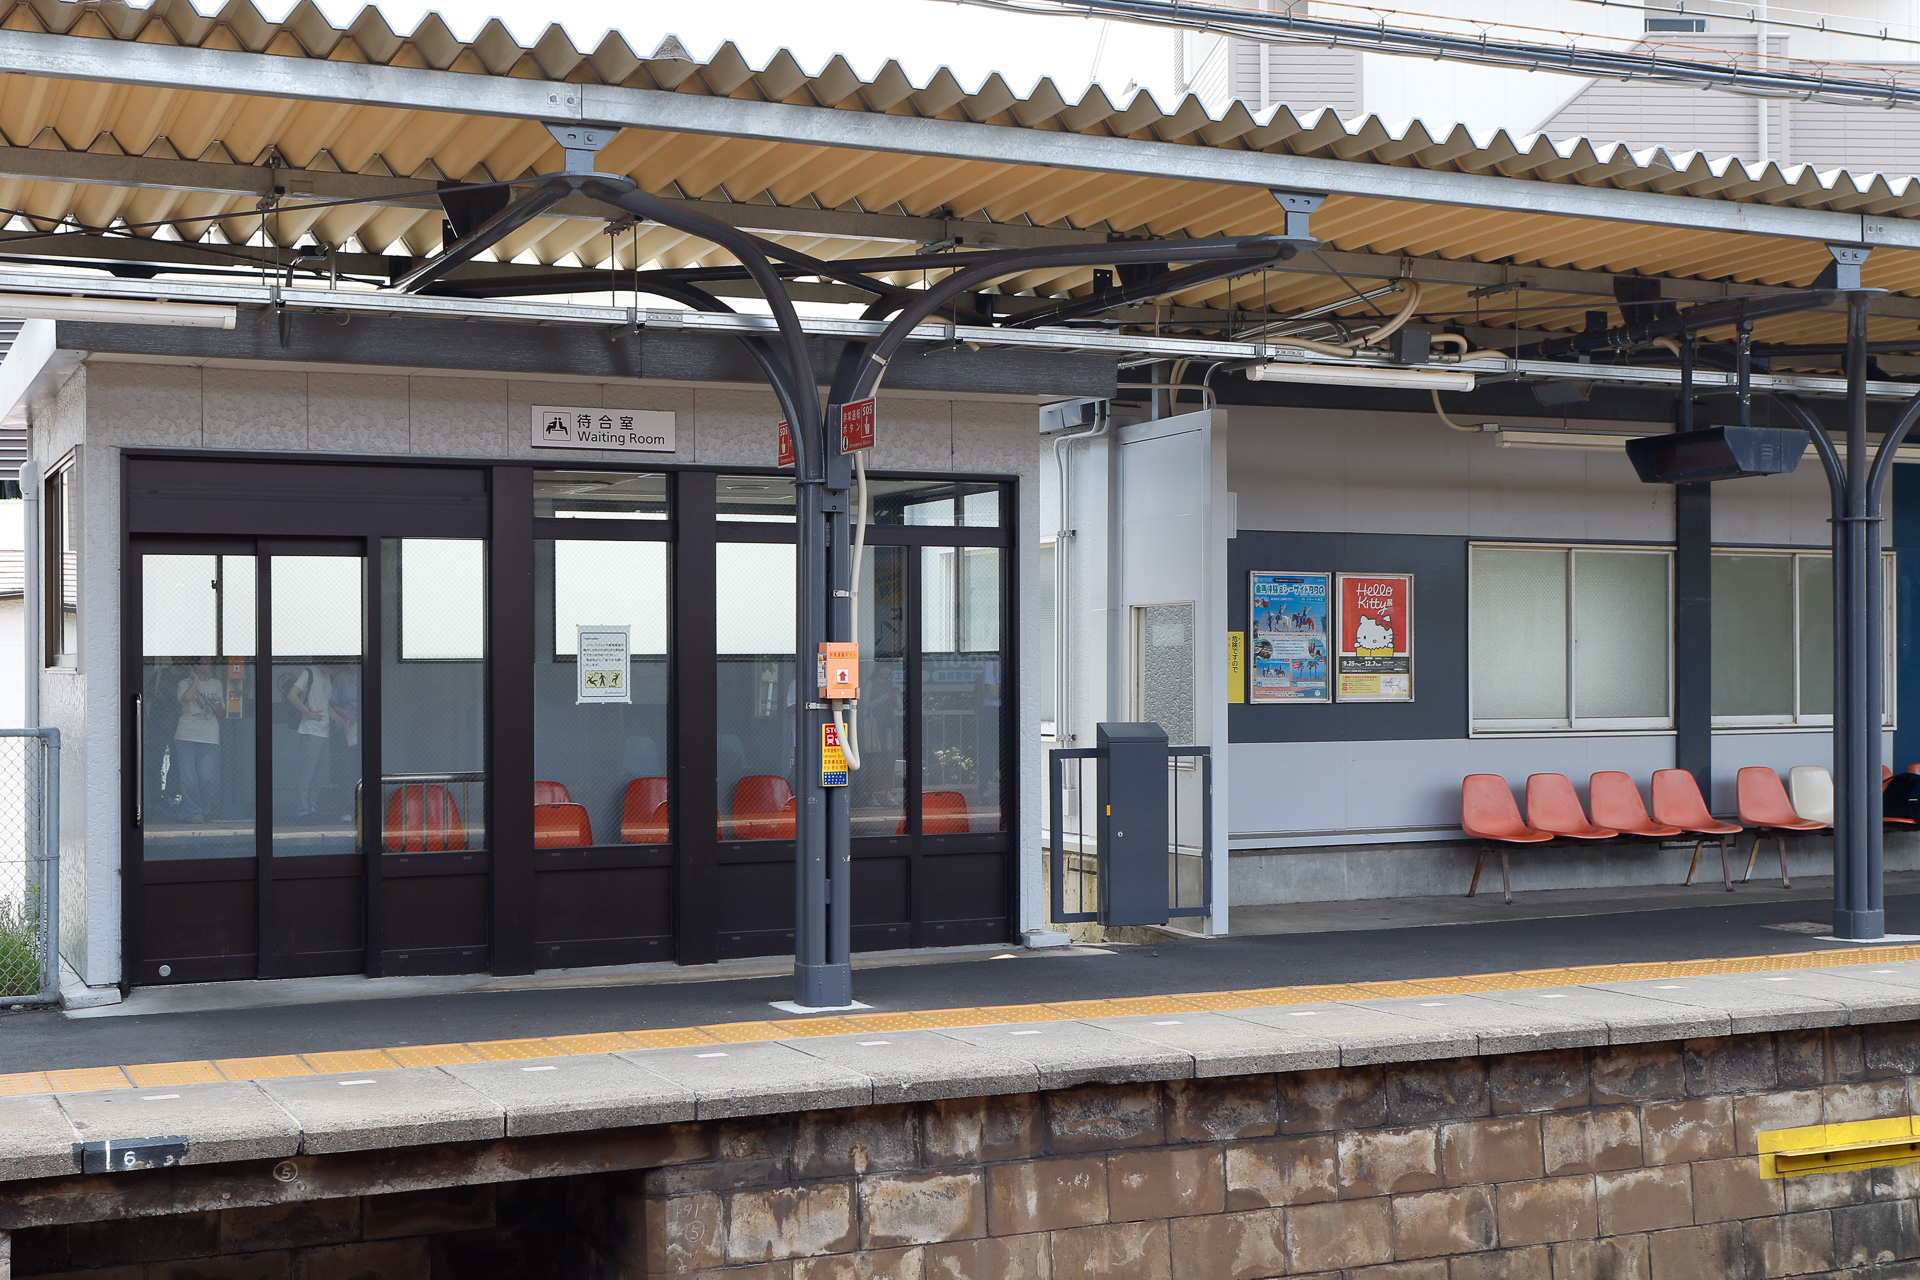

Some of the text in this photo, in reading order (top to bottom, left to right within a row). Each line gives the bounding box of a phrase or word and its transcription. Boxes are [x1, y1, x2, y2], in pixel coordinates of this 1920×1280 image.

[843, 409, 861, 422] 非常通報
[862, 405, 873, 416] SOS
[577, 413, 634, 430] 待合室
[780, 426, 788, 437] SOS
[577, 431, 665, 446] Waiting Room
[1356, 583, 1393, 597] Hello
